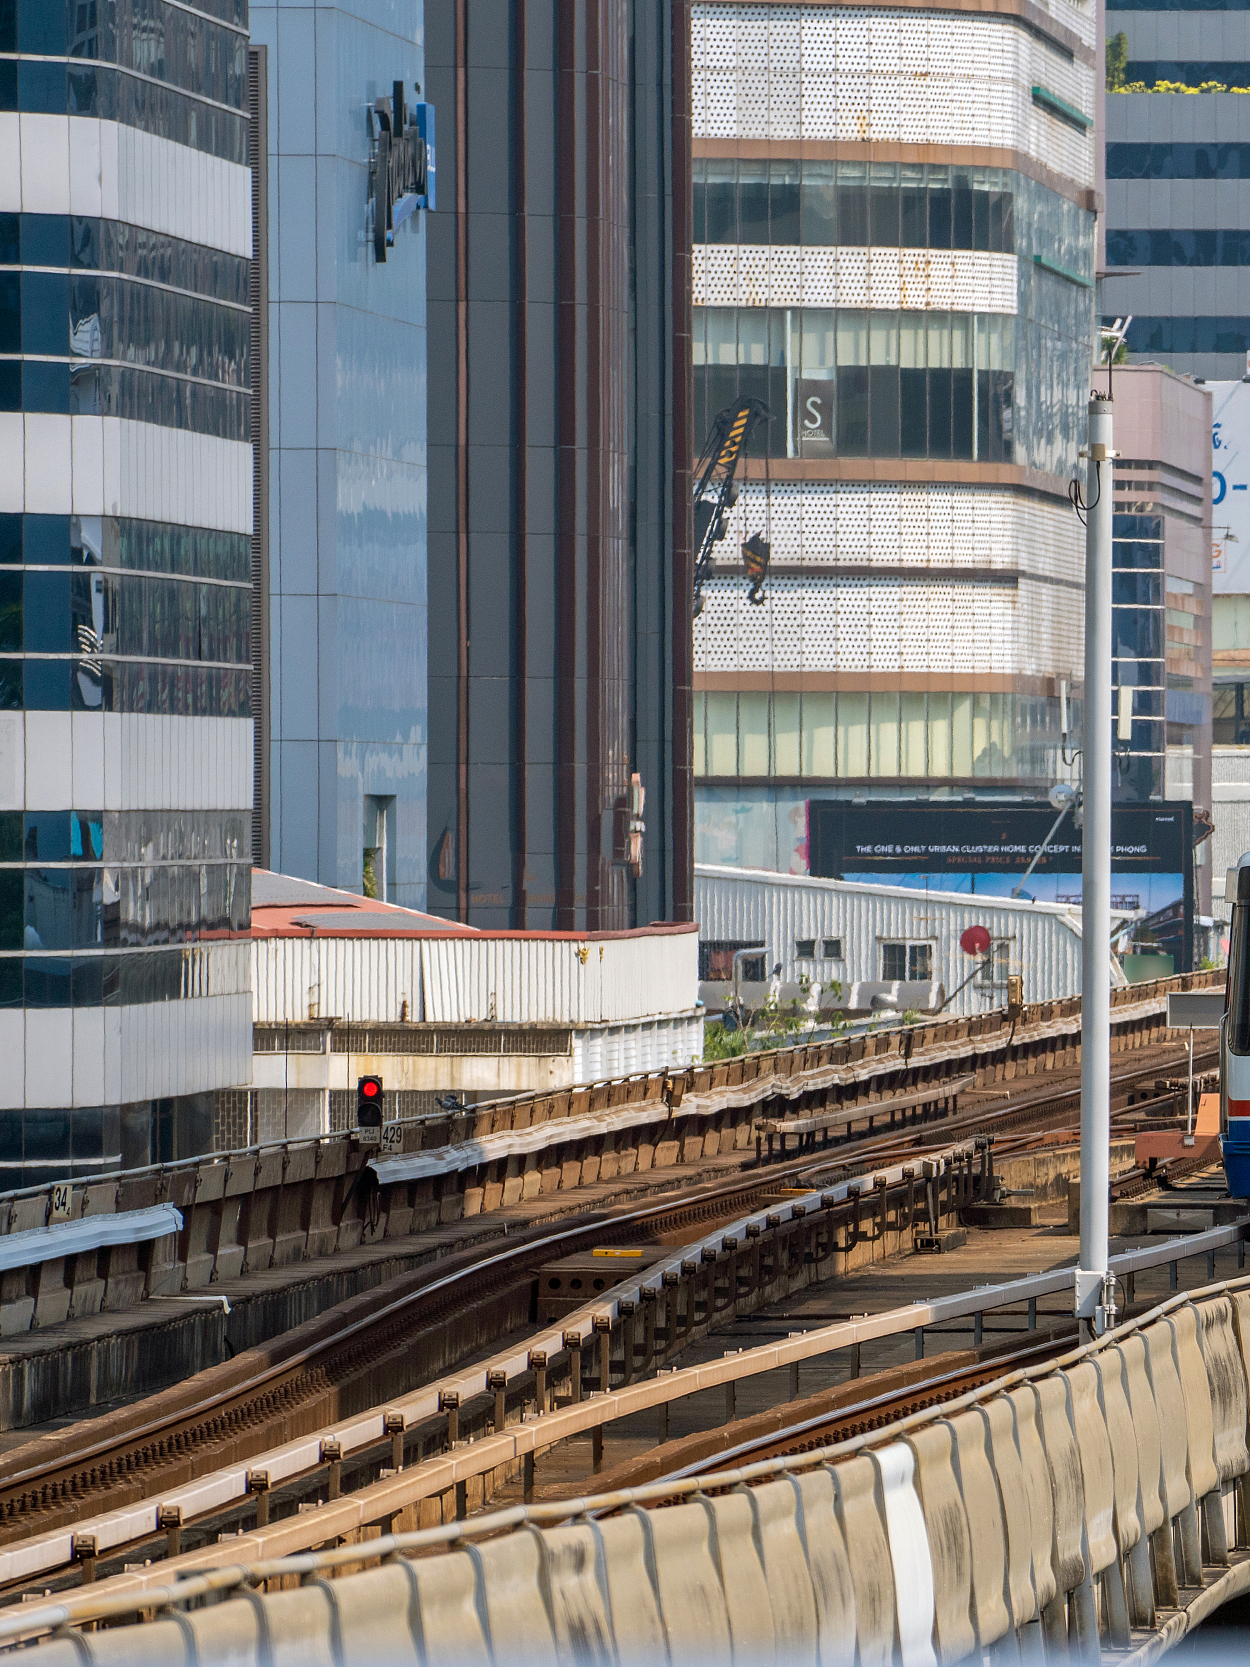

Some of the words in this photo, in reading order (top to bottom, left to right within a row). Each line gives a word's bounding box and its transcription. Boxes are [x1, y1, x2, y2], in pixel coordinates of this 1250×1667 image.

[803, 396, 822, 429] S
[855, 844, 873, 853] THE
[873, 844, 893, 853] ONE
[903, 844, 926, 853] ONLY
[928, 844, 960, 853] URBAN
[961, 844, 999, 853] CLUSTER
[1000, 844, 1026, 853] HOME
[1115, 844, 1147, 853] PHONG
[382, 1126, 402, 1144] 429
[382, 1144, 393, 1152] F4
[54, 1186, 68, 1212] 34
